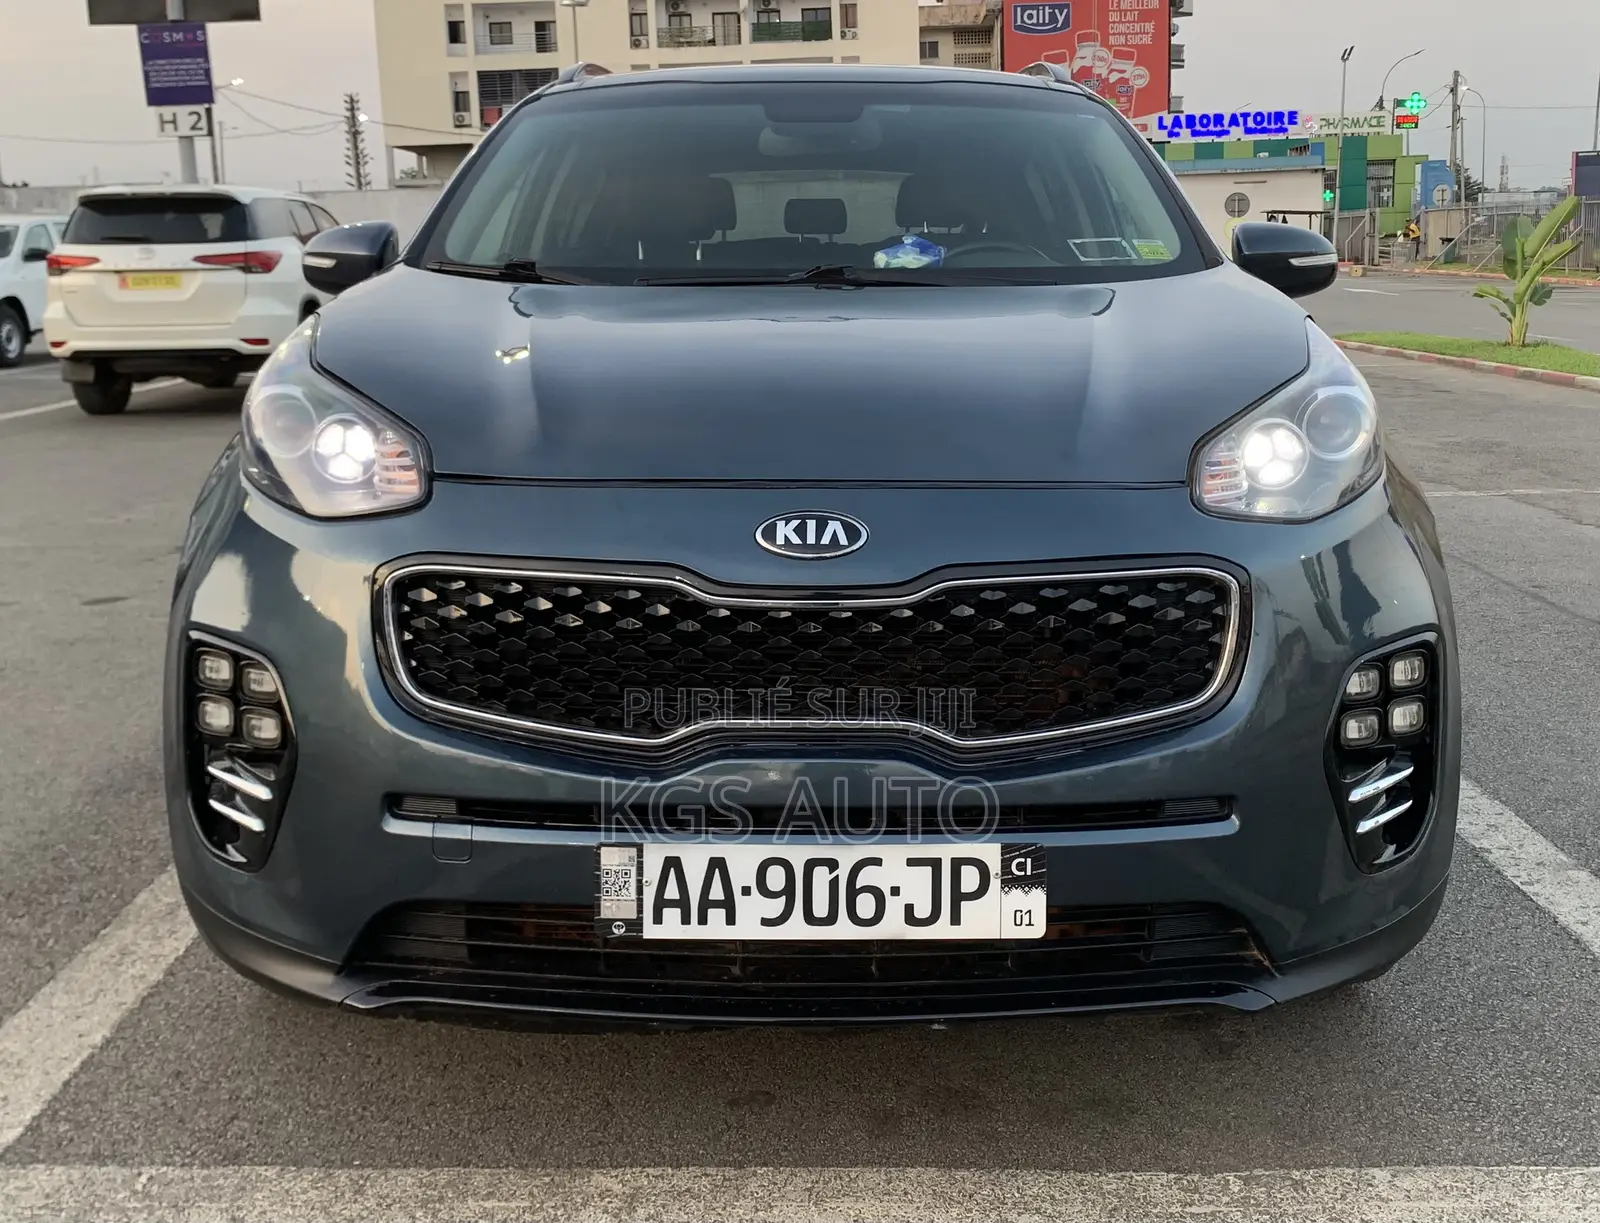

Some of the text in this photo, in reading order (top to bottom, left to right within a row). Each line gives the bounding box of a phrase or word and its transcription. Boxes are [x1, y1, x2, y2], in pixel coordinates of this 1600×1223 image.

[1109, 0, 1160, 10] LE MEILLEUR
[1109, 11, 1139, 21] DU LAIT
[1109, 20, 1155, 33] CONCENTRÉ
[1108, 32, 1153, 45] NON SUCRÉ
[159, 111, 204, 133] H 2
[1158, 111, 1298, 130] LABORATOIRE
[775, 519, 849, 546] KIA
[1011, 857, 1032, 876] CI
[1013, 909, 1035, 927] 01
